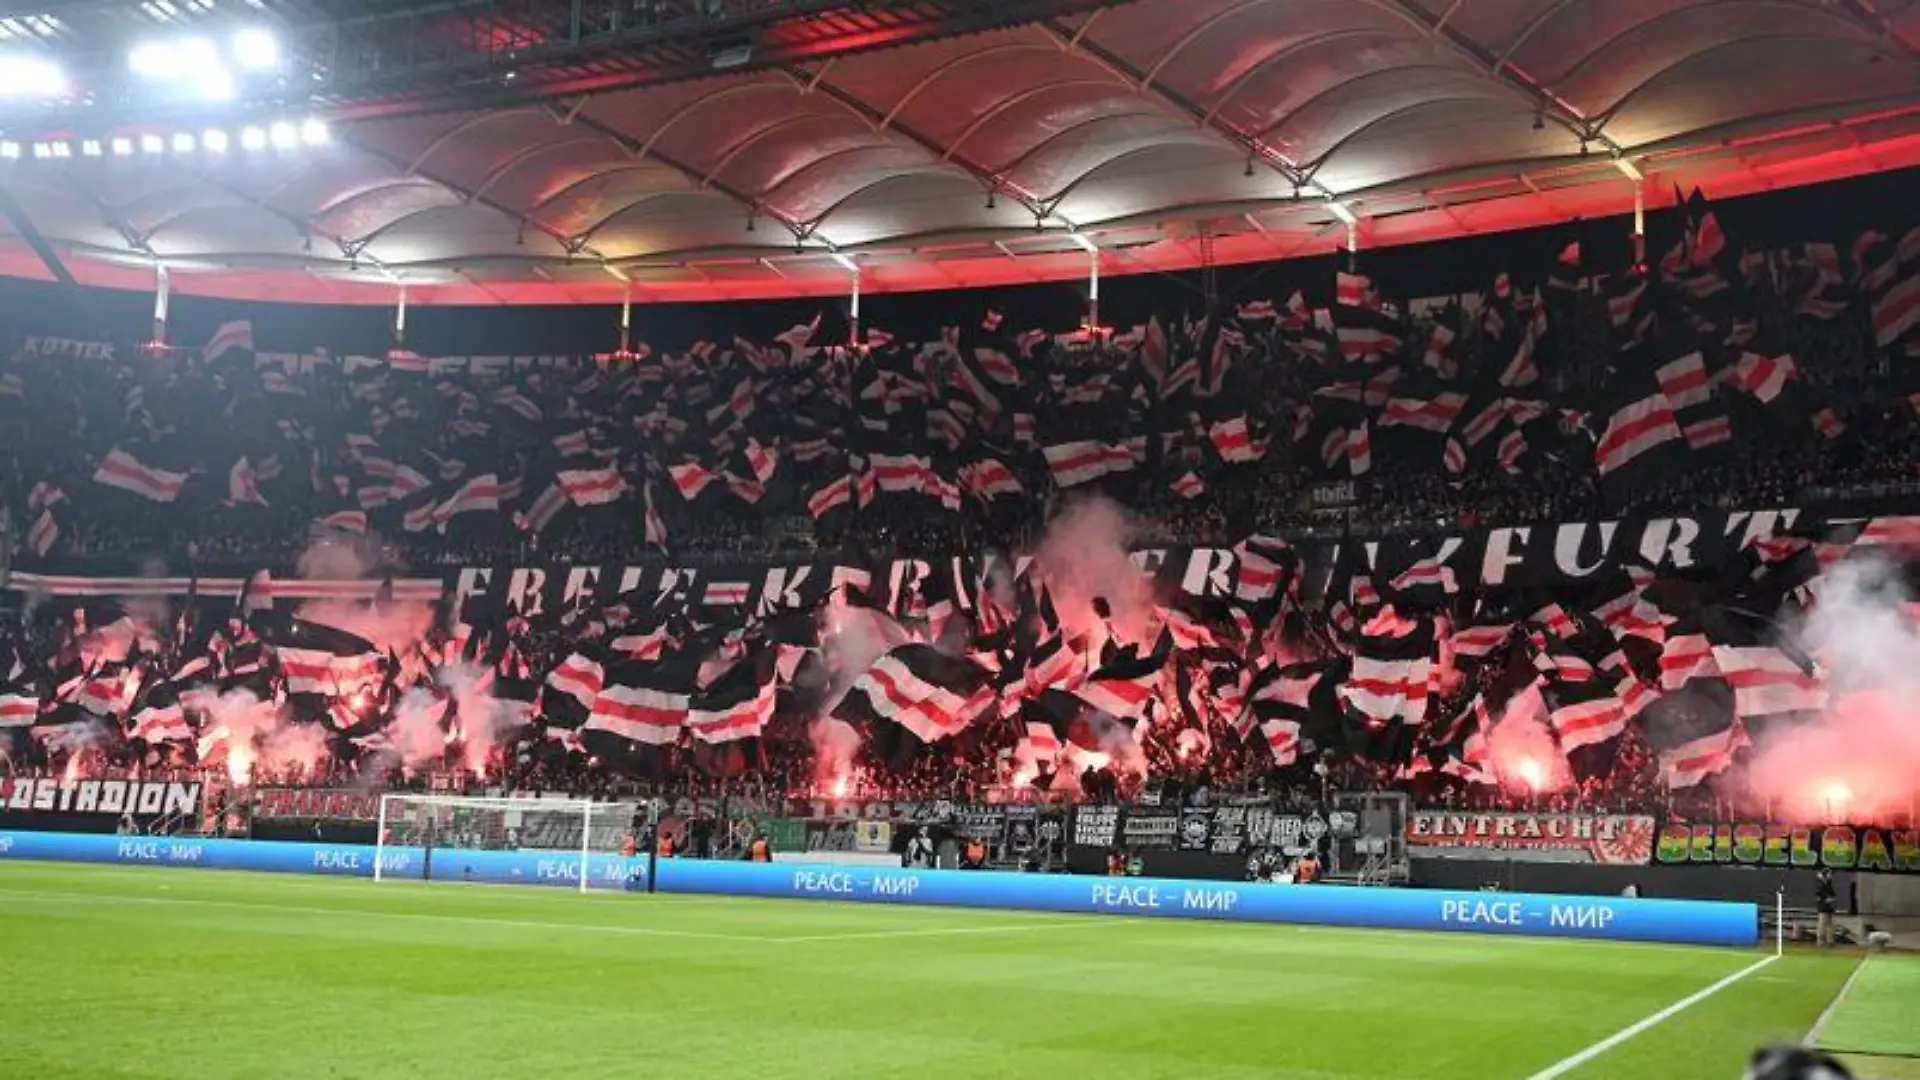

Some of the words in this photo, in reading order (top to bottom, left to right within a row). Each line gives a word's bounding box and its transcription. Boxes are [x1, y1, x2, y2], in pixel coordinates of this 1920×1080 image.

[0, 777, 200, 814] DSTADION
[1412, 815, 1620, 839] EINTRACHT
[118, 841, 158, 858] PEACE
[171, 845, 201, 860] МИР
[314, 850, 360, 868] PEACE
[794, 872, 853, 892] PEACE
[872, 875, 919, 896] МИР
[1092, 884, 1160, 906] PEACE
[1183, 889, 1237, 911] МИР
[1442, 899, 1523, 925] PEACE
[1550, 905, 1614, 928] МИР
